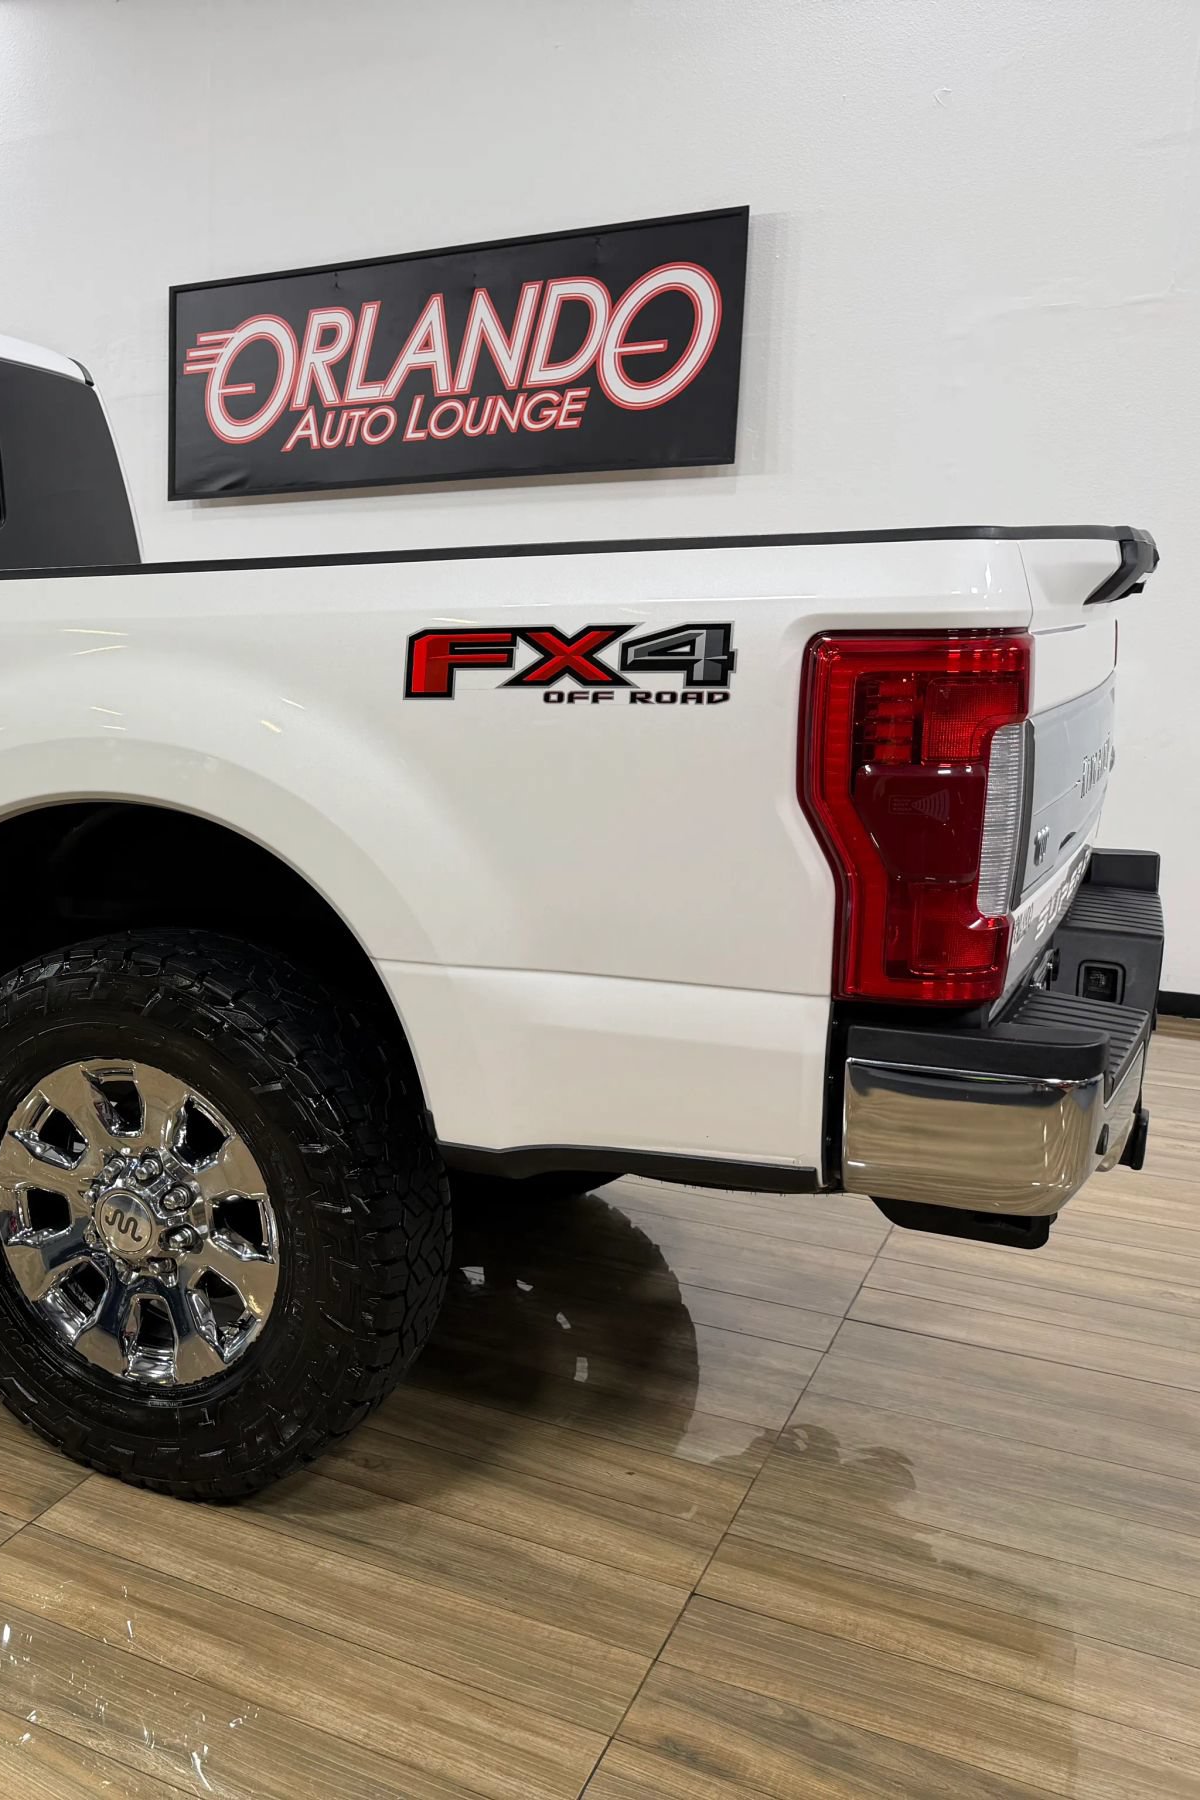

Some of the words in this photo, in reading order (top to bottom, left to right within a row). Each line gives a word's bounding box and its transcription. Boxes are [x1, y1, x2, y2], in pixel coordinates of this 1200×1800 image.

[193, 261, 722, 443] ORLANDO
[281, 405, 398, 452] AUTO
[403, 388, 591, 442] LOUNGE
[403, 621, 739, 700] FX4
[543, 690, 615, 705] OFF
[629, 690, 731, 705] ROAD
